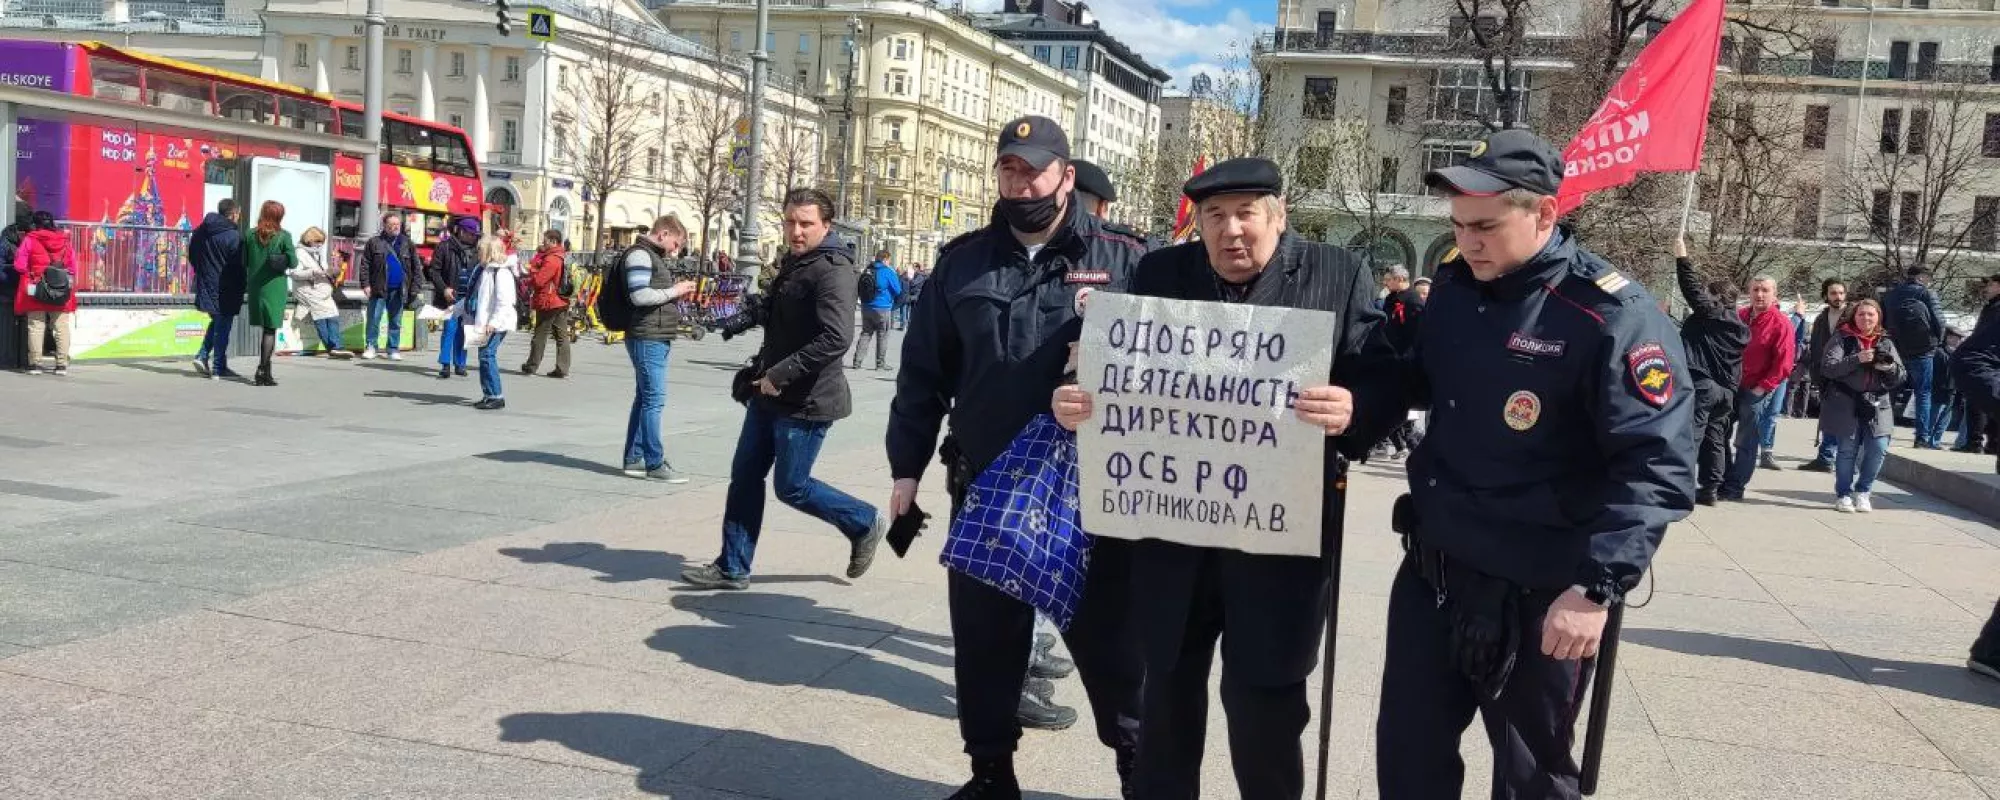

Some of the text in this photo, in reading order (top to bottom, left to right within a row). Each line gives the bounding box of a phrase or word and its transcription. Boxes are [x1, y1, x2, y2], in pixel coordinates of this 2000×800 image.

[354, 24, 446, 40] МЫЙ ТЕАТР
[1108, 318, 1285, 362] ОДОБРЯЮ
[1511, 336, 1562, 353] ПОЛИЦИЯ
[1098, 363, 1300, 409] ДЕЯТЕЛЬНОСТЬ
[1101, 403, 1278, 448] ДИРЕКТОРА
[1105, 451, 1248, 500] ФСБ РФ
[1102, 488, 1289, 533] БОРТНИКОВА А.В.
